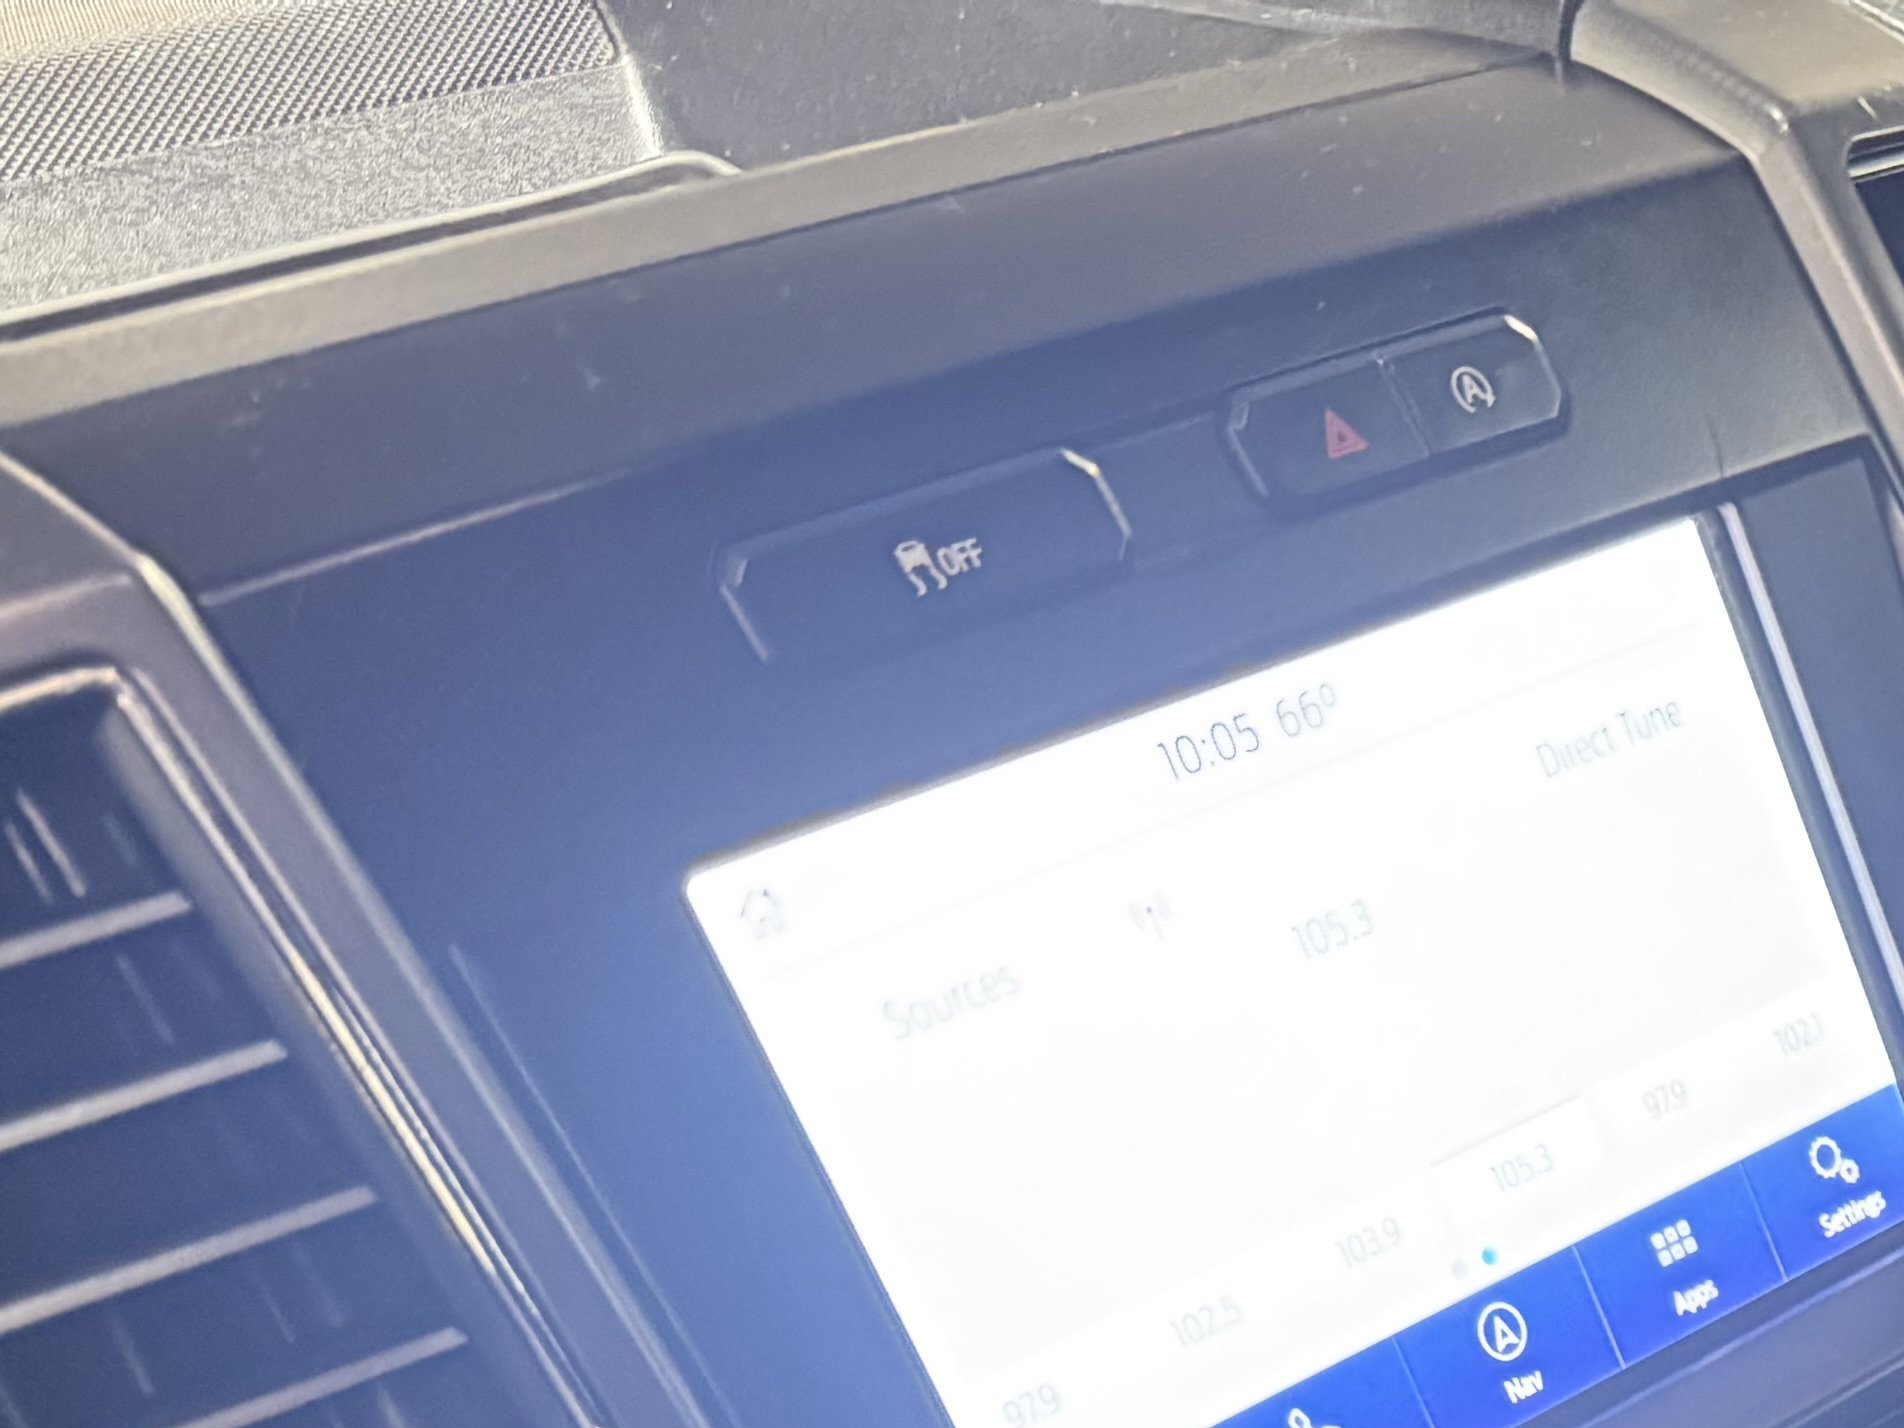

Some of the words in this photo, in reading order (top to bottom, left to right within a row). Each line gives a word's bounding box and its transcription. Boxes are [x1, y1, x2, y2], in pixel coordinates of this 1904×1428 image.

[937, 537, 983, 577] OFF
[1156, 713, 1261, 781] 10:05
[1535, 719, 1612, 779] Direct
[1614, 697, 1687, 756] Tune
[1289, 897, 1376, 960] 105.3
[880, 961, 1021, 1041] Sources
[1489, 1142, 1556, 1195] 105.3
[1818, 1187, 1887, 1239] Settings
[1334, 1216, 1403, 1269] 103.9
[1169, 1294, 1245, 1349] 102.5
[1673, 1279, 1719, 1316] Apps
[1504, 1370, 1544, 1404] Nav
